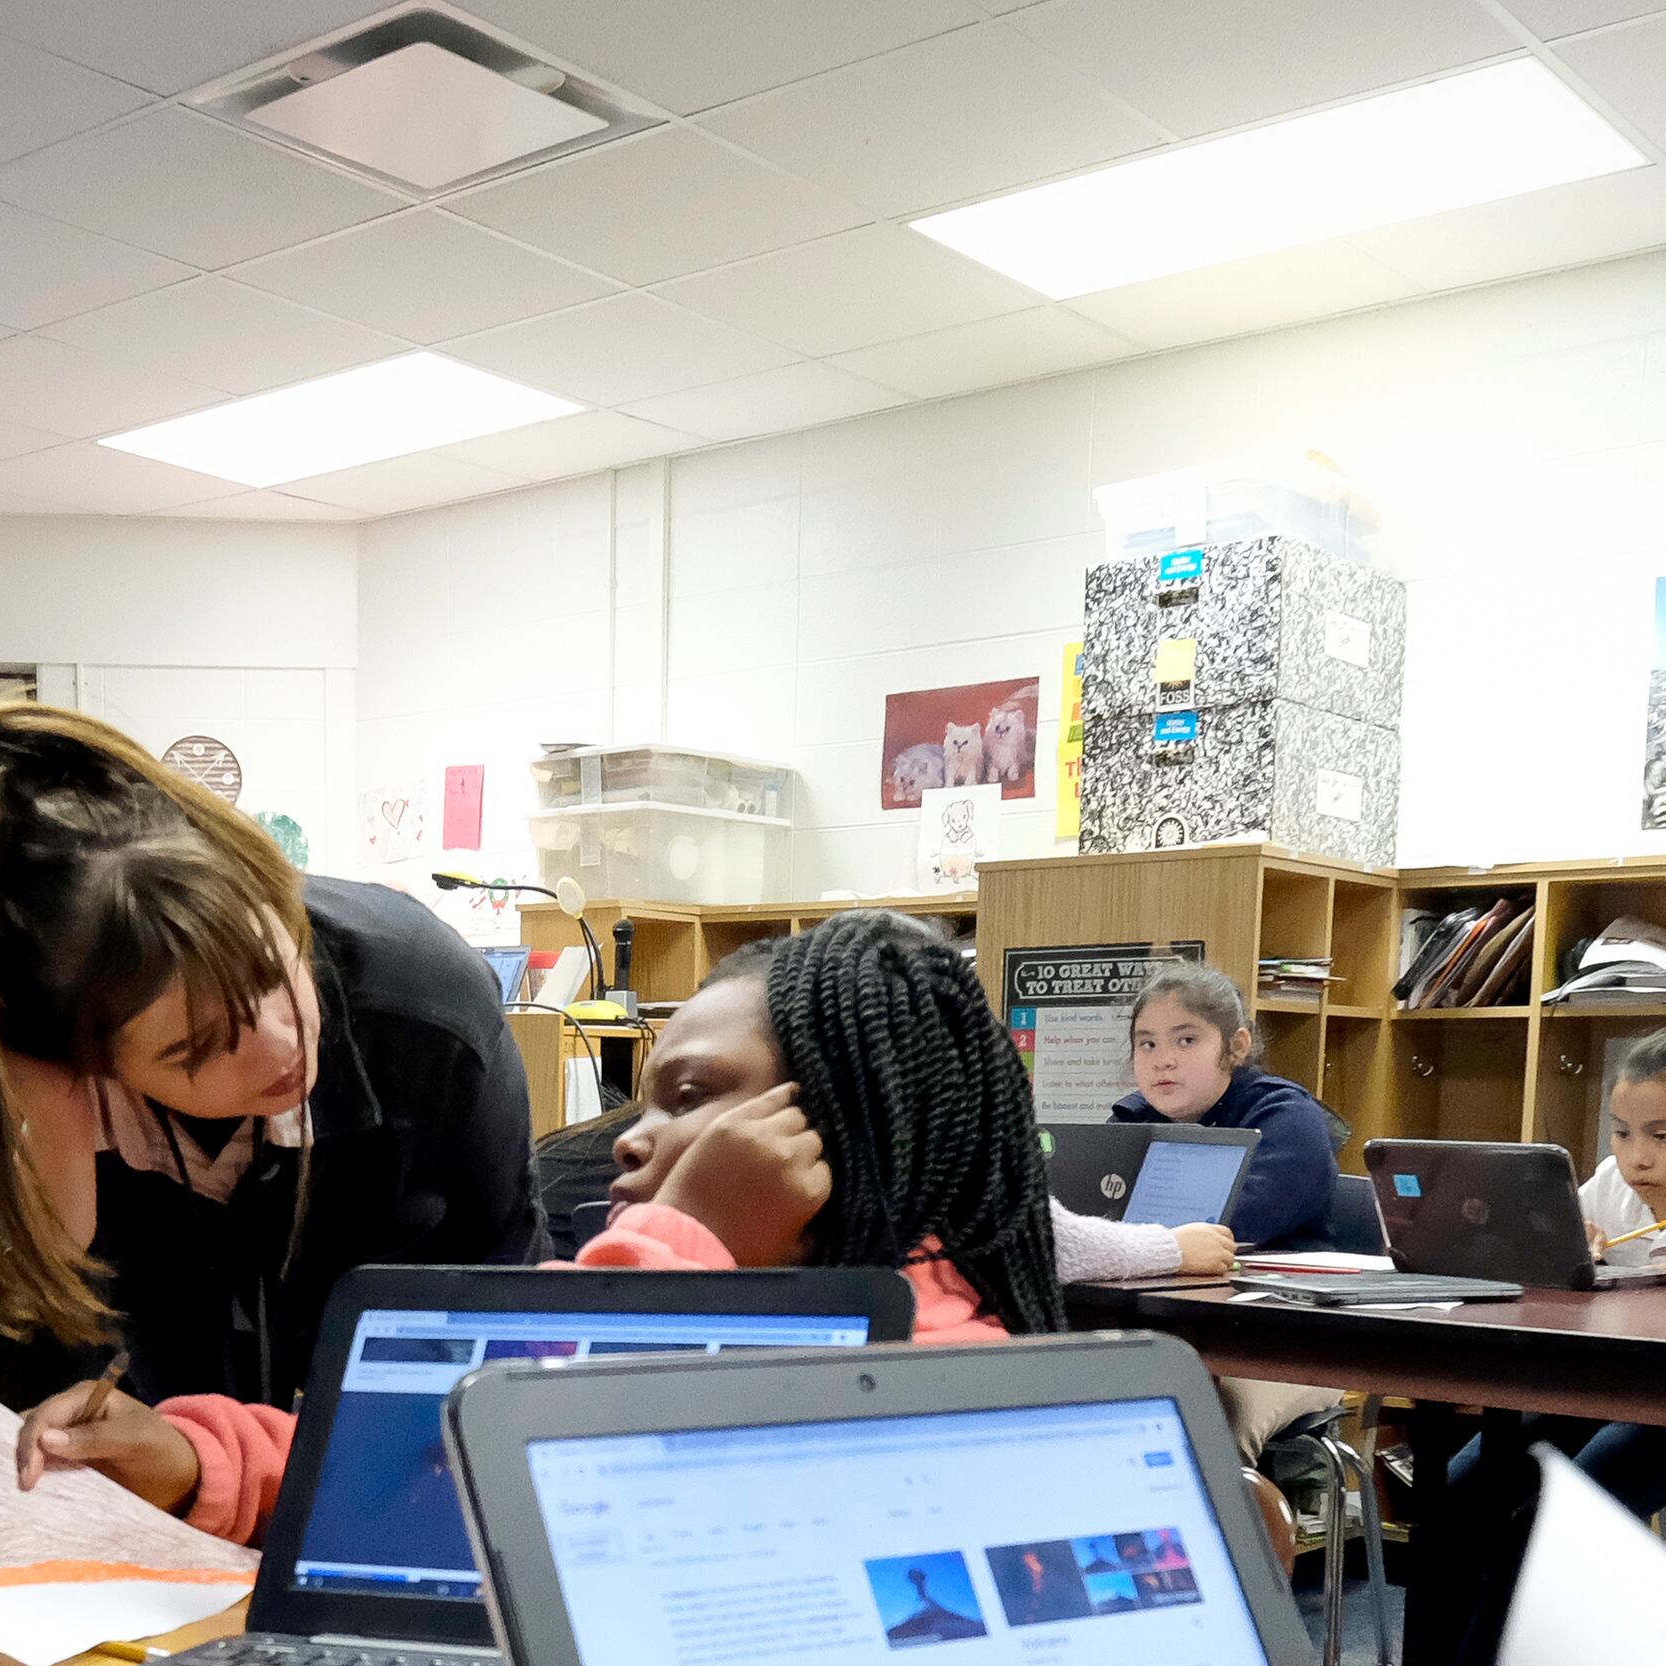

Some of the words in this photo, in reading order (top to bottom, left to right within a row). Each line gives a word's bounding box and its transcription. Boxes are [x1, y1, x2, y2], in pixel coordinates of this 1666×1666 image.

[1160, 689, 1191, 705] FOSS
[1037, 965, 1056, 979] 10
[1058, 961, 1113, 978] GREAT
[1025, 980, 1048, 994] TO
[1051, 978, 1103, 994] TREAT
[1019, 1011, 1028, 1026] 1
[1019, 1033, 1028, 1047] 2
[1102, 1174, 1125, 1199] hp
